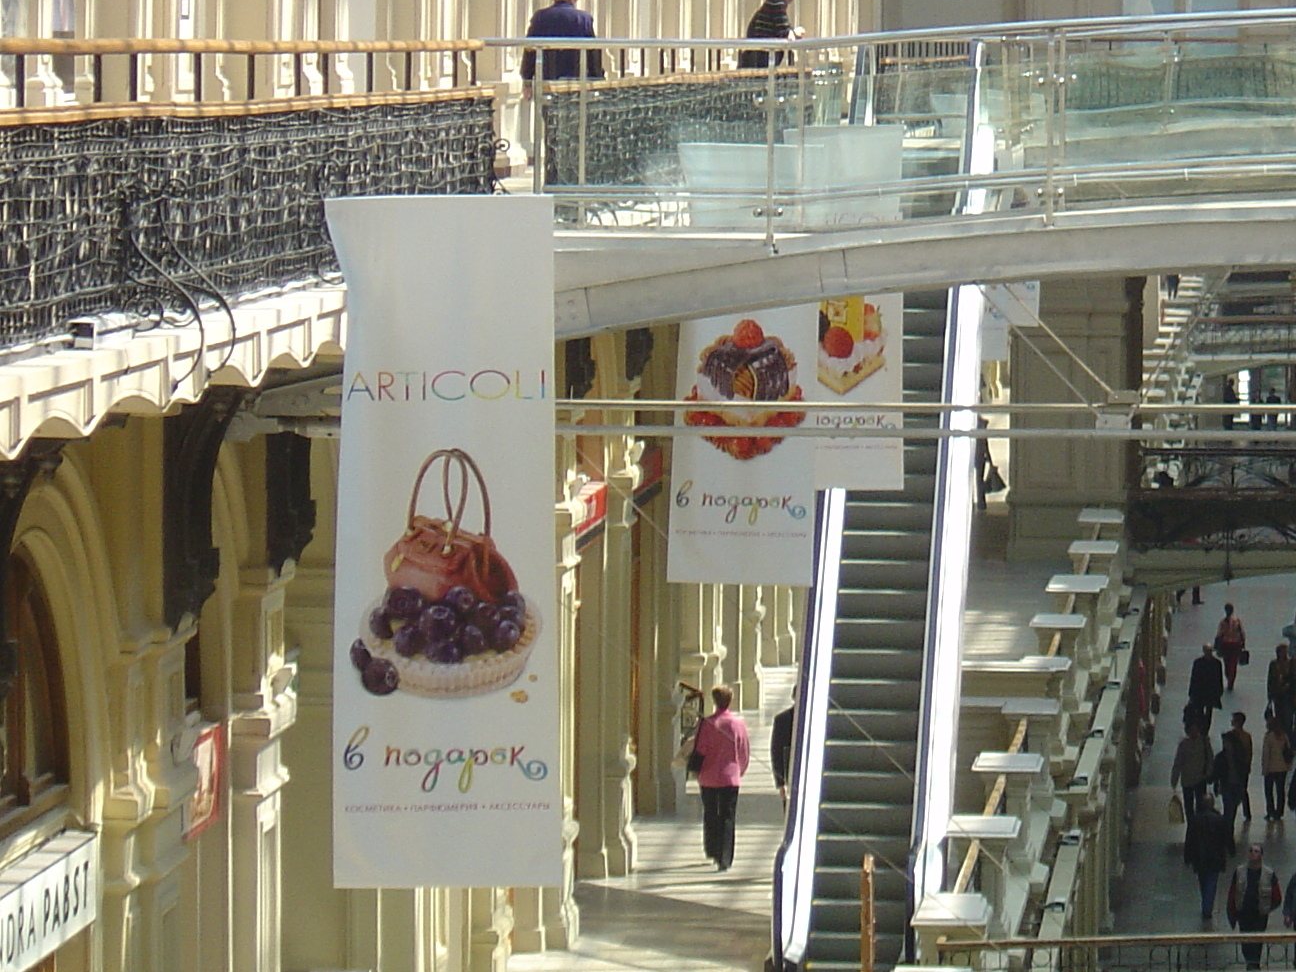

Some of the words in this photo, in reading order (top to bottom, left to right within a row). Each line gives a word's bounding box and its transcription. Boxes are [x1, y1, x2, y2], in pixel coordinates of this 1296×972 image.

[347, 369, 546, 401] ARTICOLI
[702, 492, 807, 525] подарок
[384, 745, 548, 794] подарок
[344, 804, 401, 813] КОСМЕТИКА
[410, 803, 478, 812] ПАРФЮМЕРИЯ
[488, 802, 550, 811] АКСЕССУАРЫ
[43, 860, 89, 939] PABST
